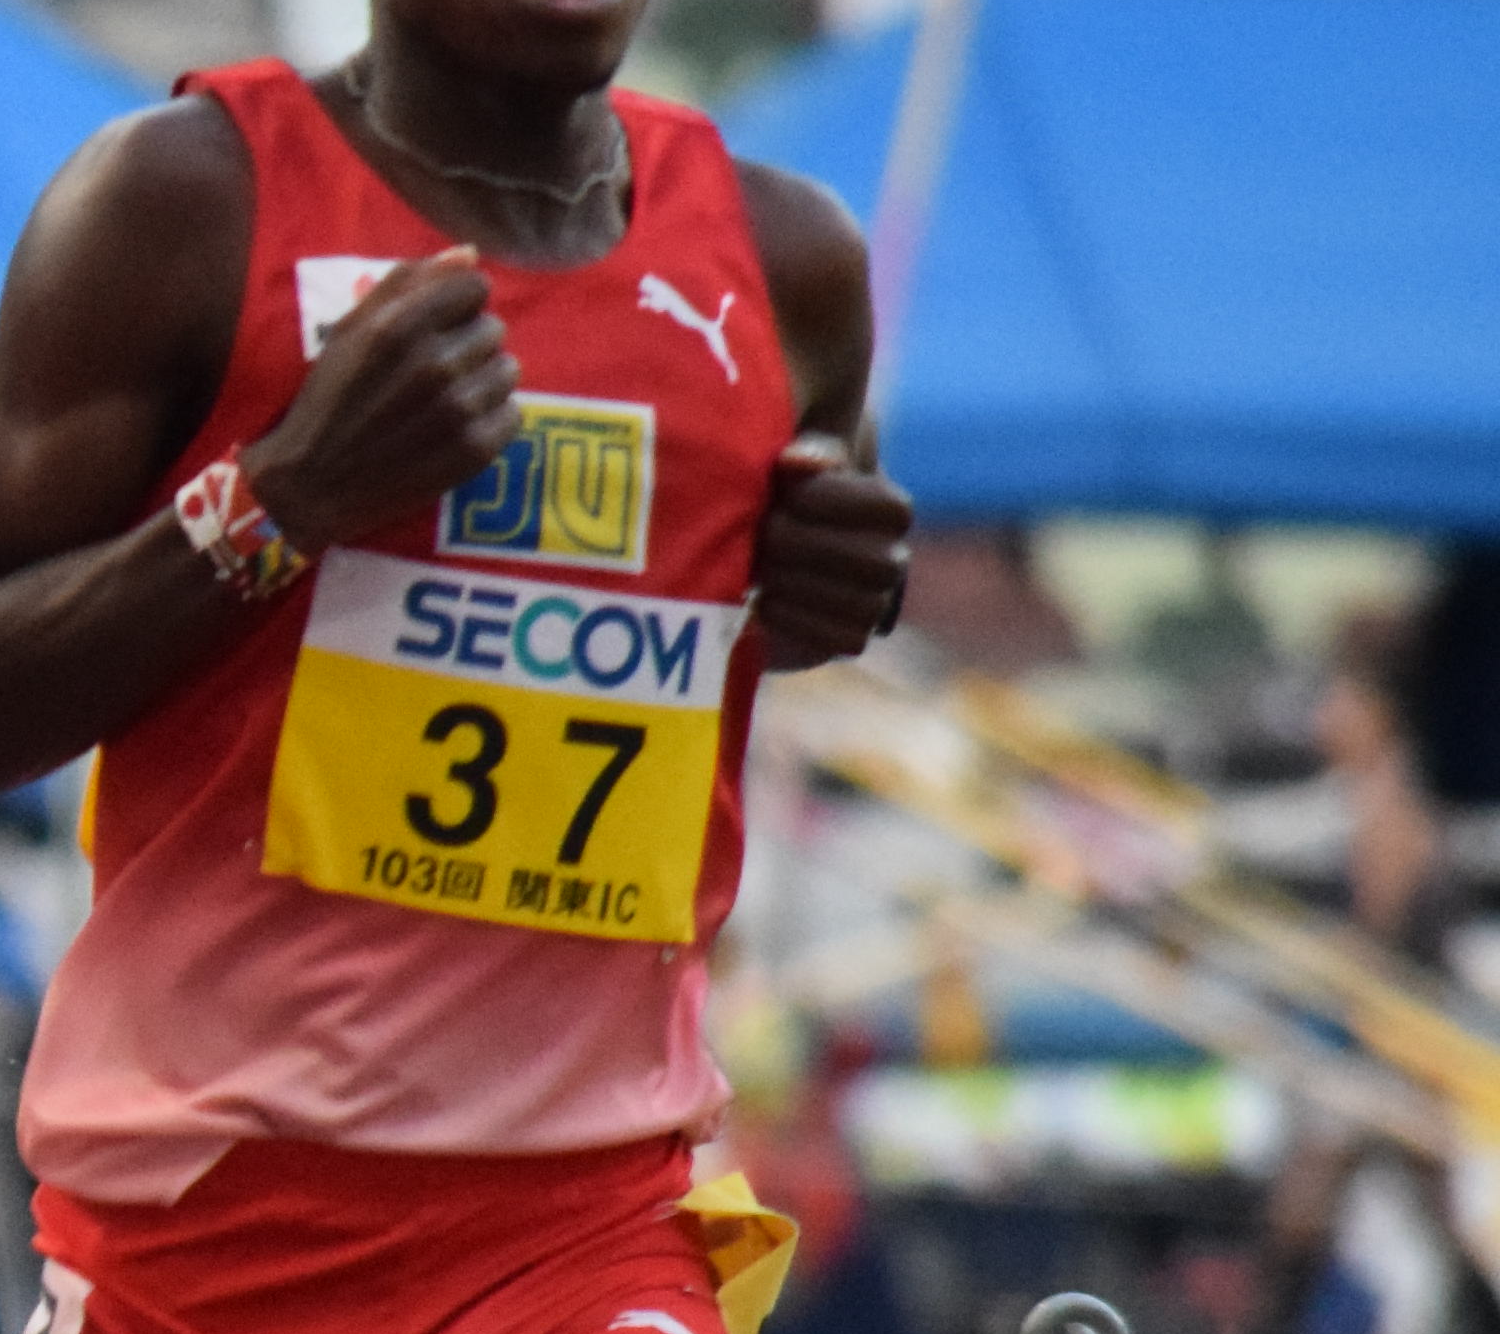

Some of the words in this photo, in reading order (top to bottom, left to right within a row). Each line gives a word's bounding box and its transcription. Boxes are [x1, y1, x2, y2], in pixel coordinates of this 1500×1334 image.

[396, 581, 702, 695] SECOM
[404, 702, 648, 867] 37
[358, 845, 487, 903] 103回
[504, 867, 642, 924] 関東IC
